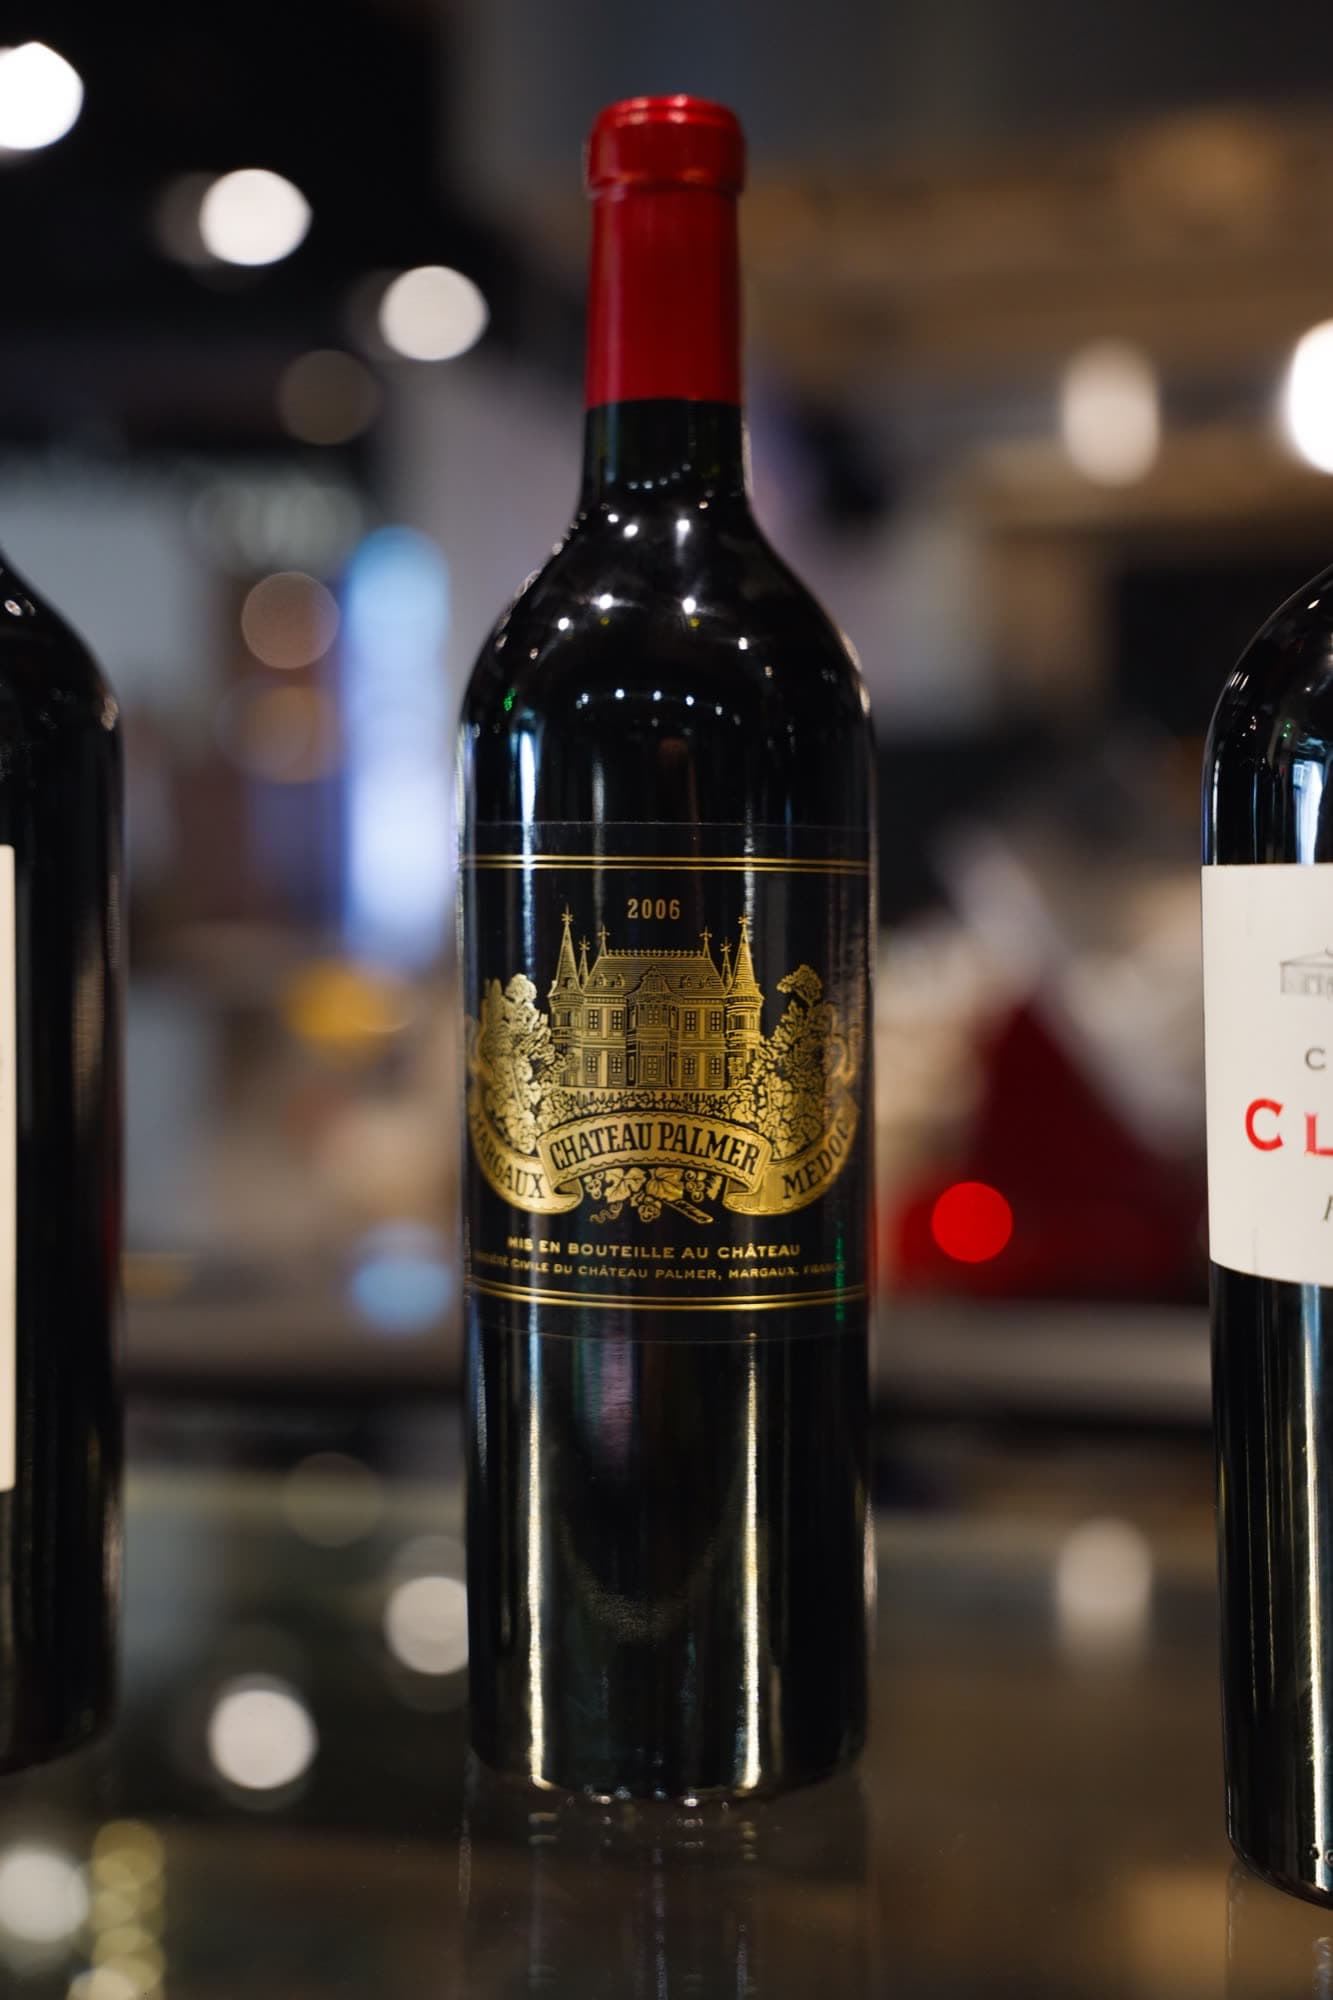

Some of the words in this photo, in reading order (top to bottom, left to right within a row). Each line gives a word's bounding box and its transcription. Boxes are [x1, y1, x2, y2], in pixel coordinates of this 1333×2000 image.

[627, 898, 681, 920] 2006
[1244, 1098, 1333, 1156] CL
[549, 1123, 653, 1170] CHATEAU
[657, 1121, 761, 1176] PALMER
[508, 1237, 533, 1251] MIS
[538, 1239, 561, 1254] EN
[568, 1243, 674, 1258] BOUTEILLE
[681, 1247, 709, 1259] AU
[717, 1242, 801, 1259] CHÂTEAU
[511, 1258, 549, 1273] CIVILE
[553, 1263, 573, 1275] DU
[578, 1264, 649, 1279] CHÂTEAU
[655, 1268, 722, 1281] PALMER,
